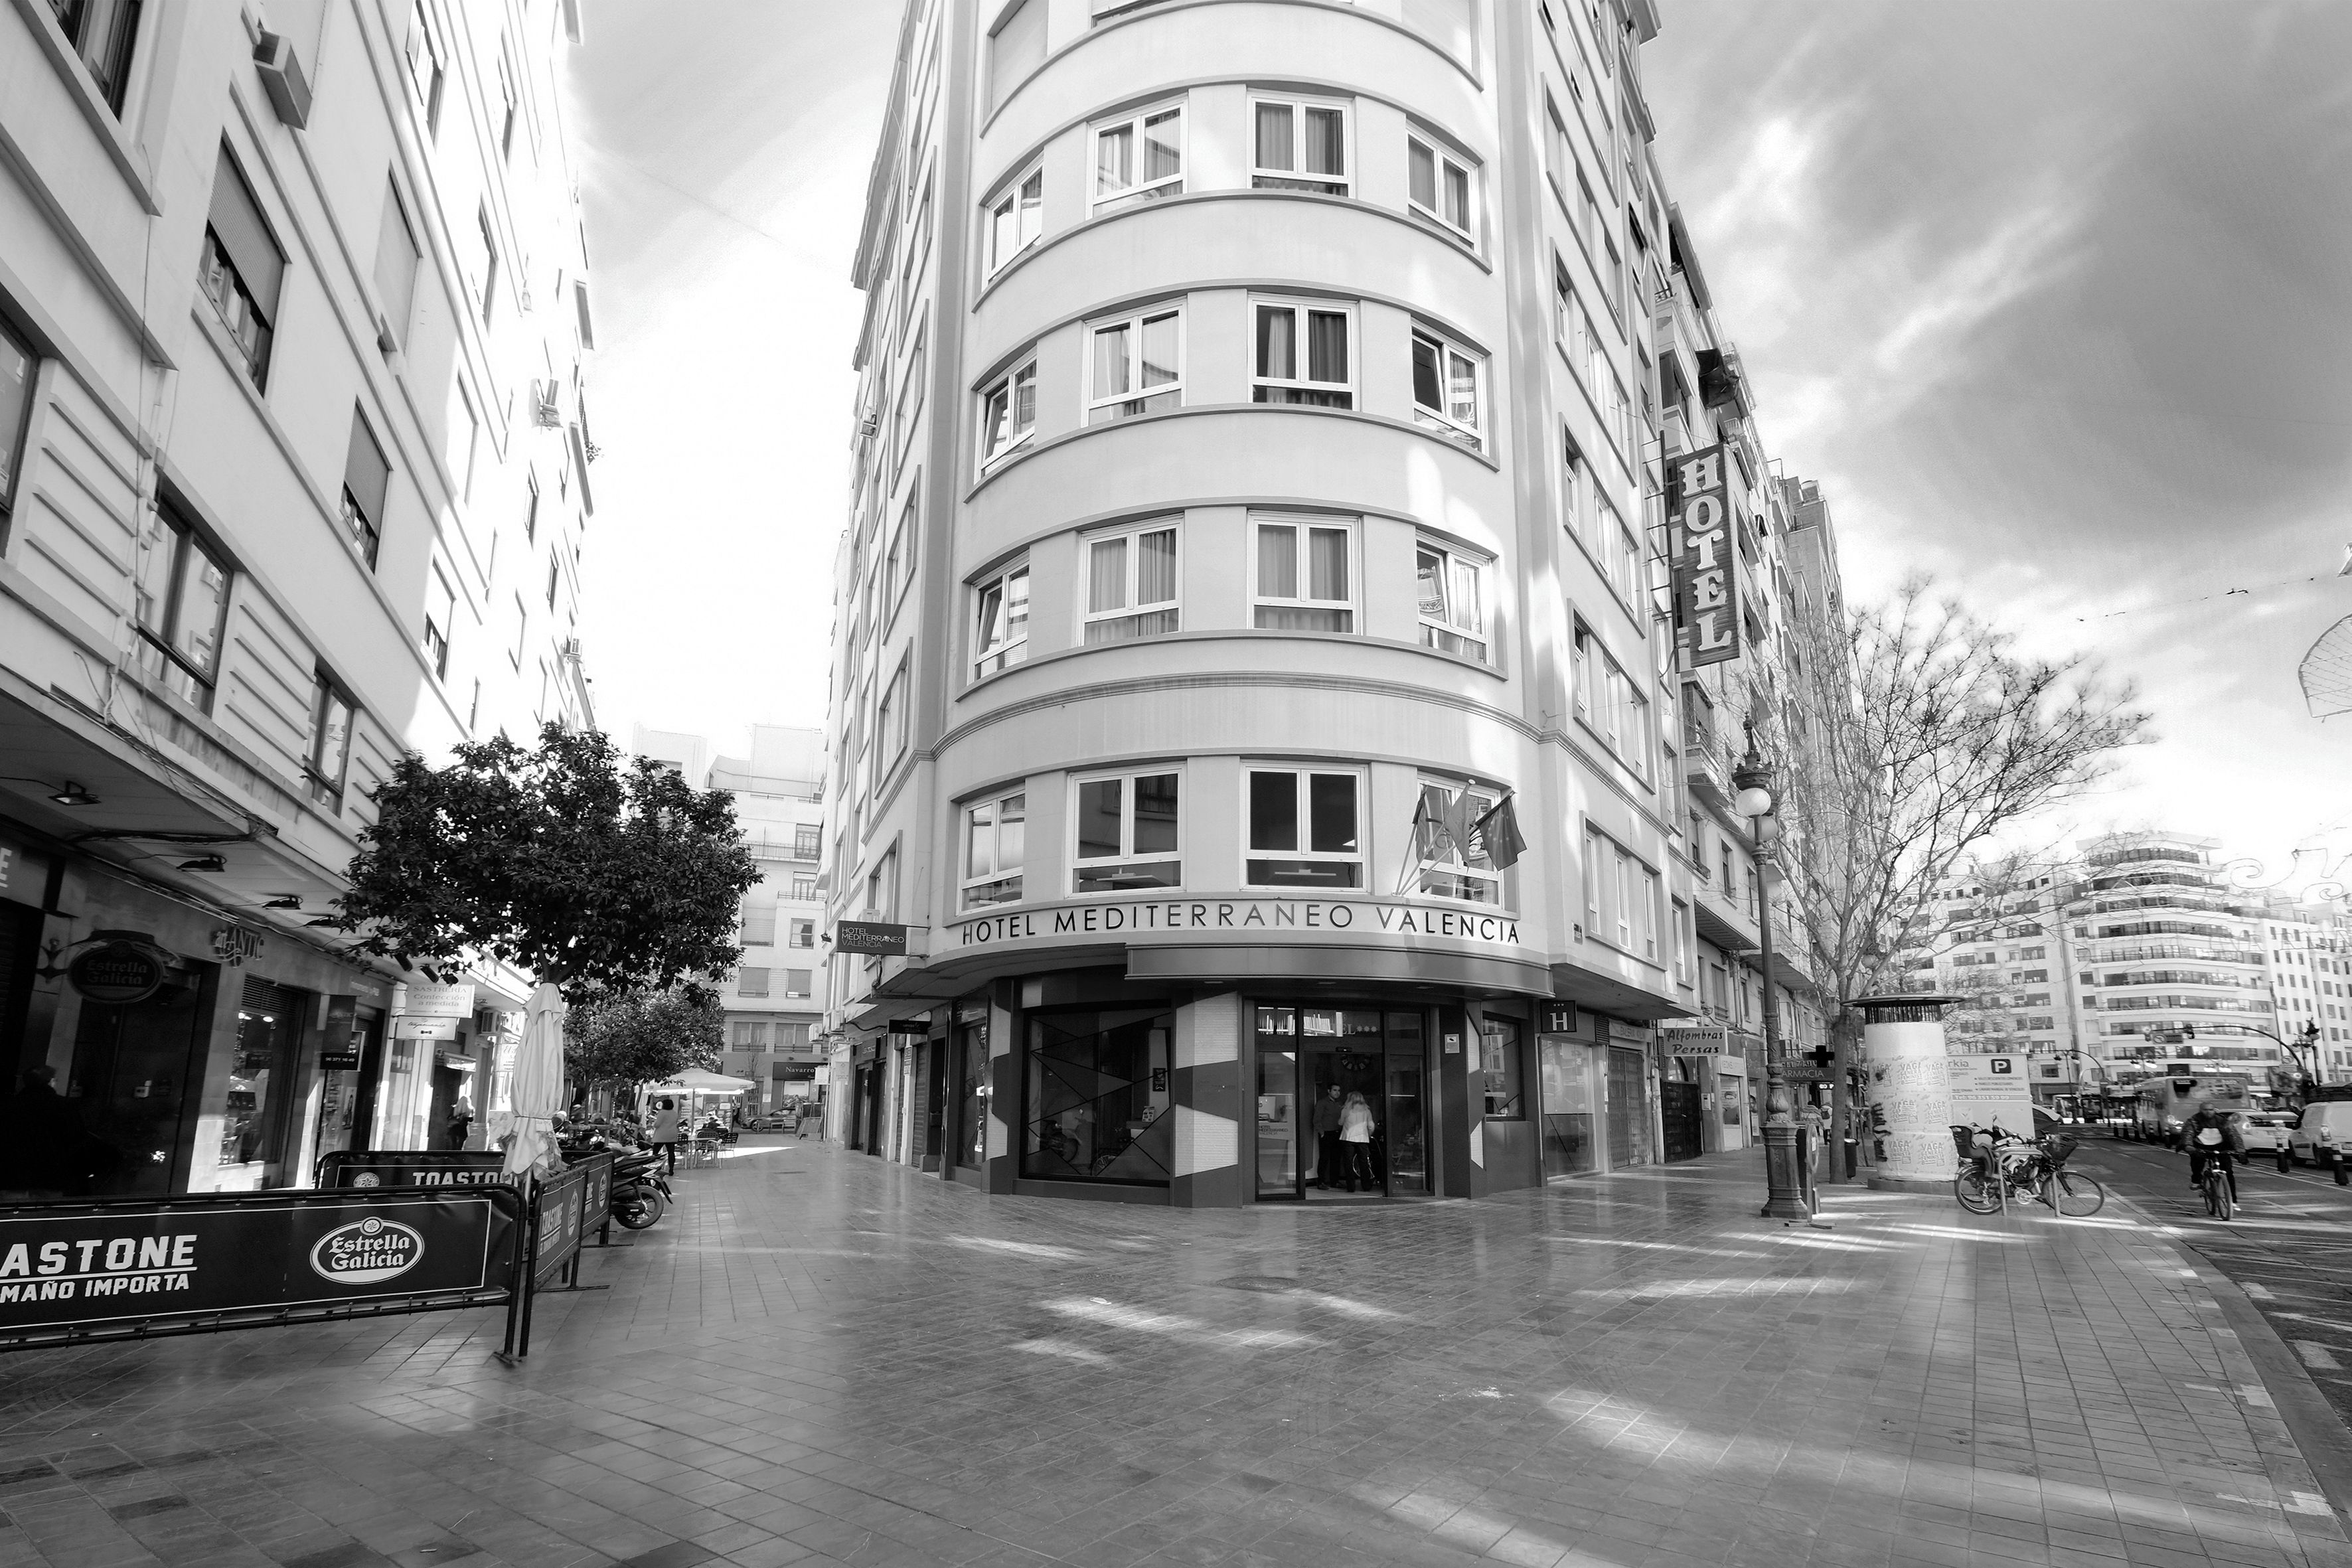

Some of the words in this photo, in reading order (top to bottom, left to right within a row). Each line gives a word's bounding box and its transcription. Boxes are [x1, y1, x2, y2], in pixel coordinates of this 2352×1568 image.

[1681, 453, 1731, 651] HOTEL
[963, 915, 1036, 945] HOTEL
[1055, 904, 1352, 933] MEDITERRANEO
[1376, 907, 1520, 943] VALENCIA
[841, 933, 904, 943] MEDITERRANEO
[1549, 1012, 1568, 1031] H
[1667, 1030, 1723, 1042] Alfombras
[1672, 1044, 1719, 1054] Persas
[1780, 1069, 1824, 1077] ARMACIA
[1994, 1060, 2007, 1072] P
[329, 1235, 410, 1253] Estrella
[0, 1235, 197, 1277] ASTONE
[332, 1251, 404, 1270] Galicia
[0, 1281, 75, 1303] MAÑO
[85, 1273, 189, 1296] IMPORTA
